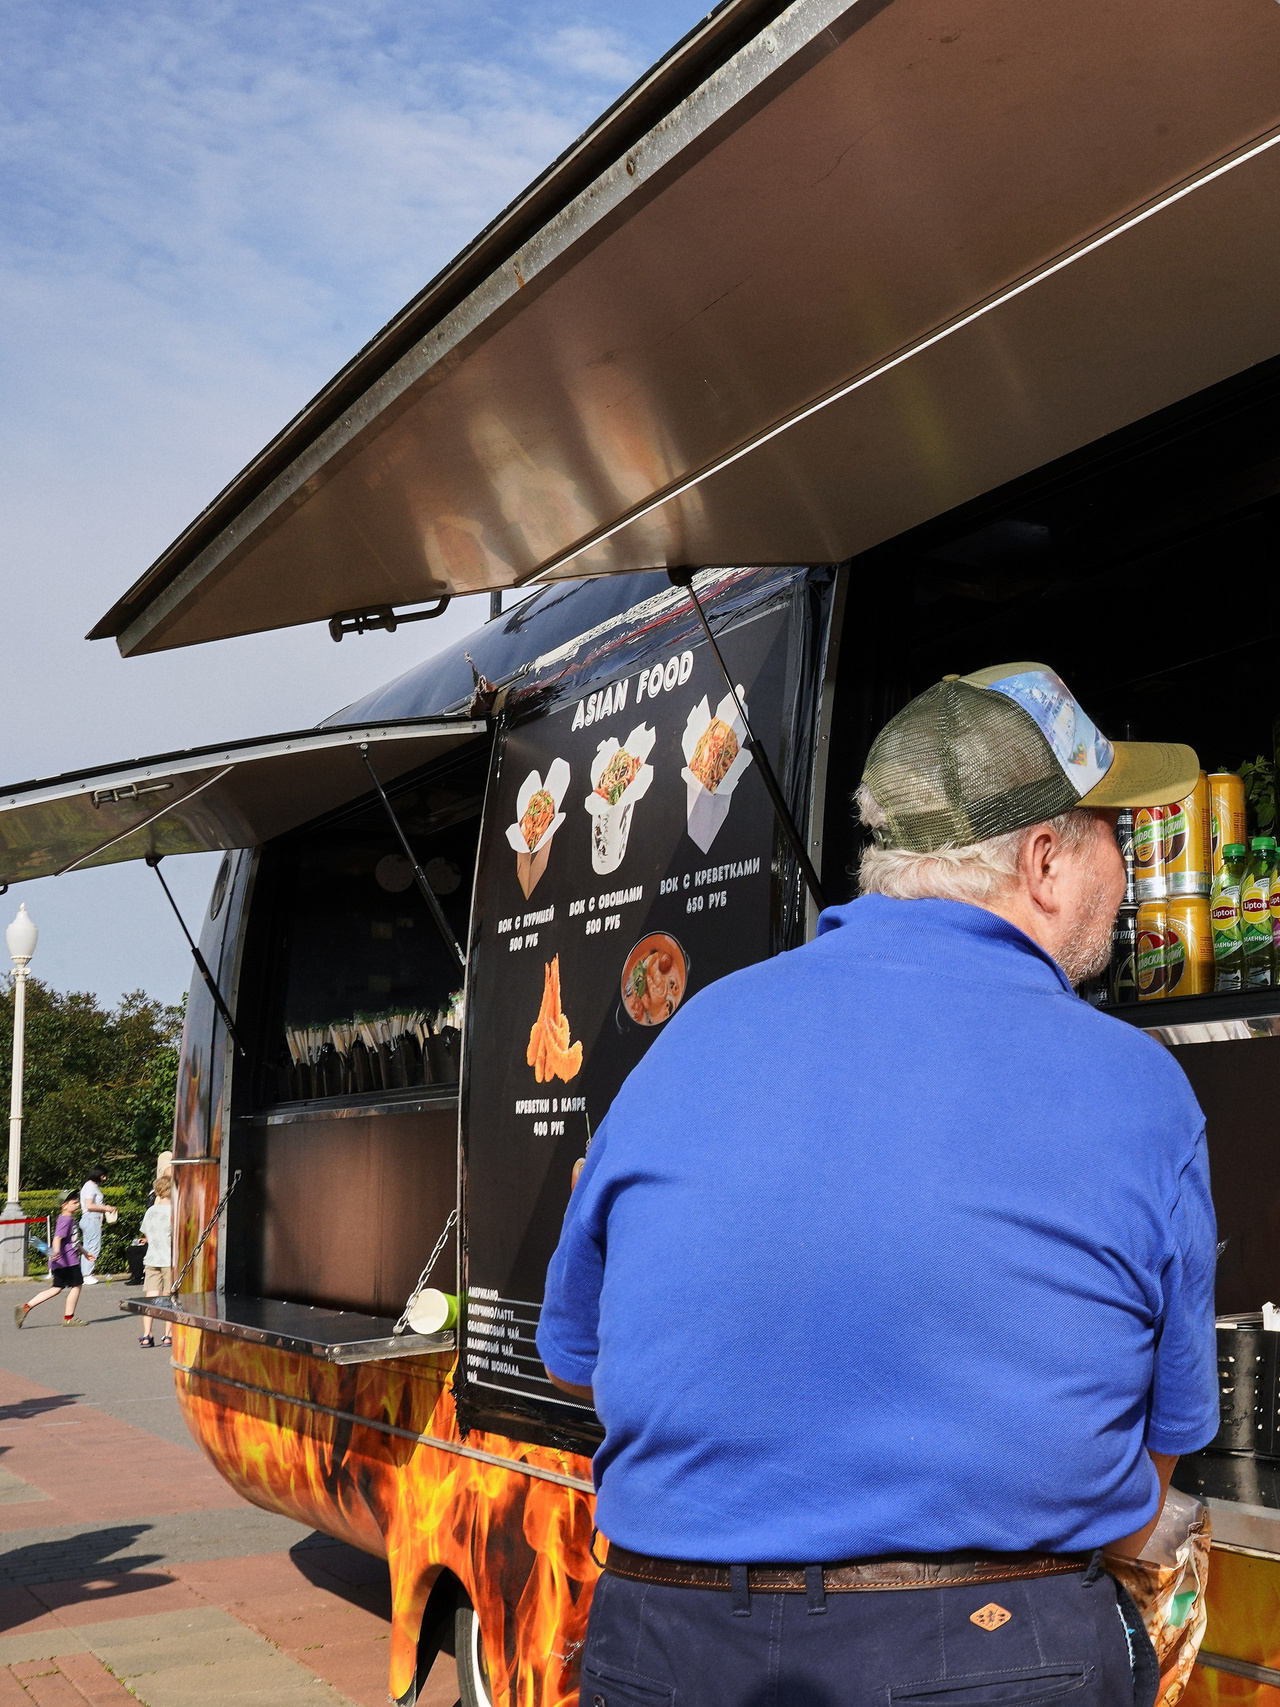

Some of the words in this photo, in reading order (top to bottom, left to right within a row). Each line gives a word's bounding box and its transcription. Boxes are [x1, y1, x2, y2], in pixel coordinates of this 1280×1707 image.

[571, 679, 629, 732] ASIAN
[636, 650, 694, 703] FOOD
[660, 876, 679, 895] ВОК
[683, 873, 691, 889] С
[694, 857, 760, 887] КРЕВЕТКАМИ
[569, 899, 586, 916] ВОК
[588, 896, 596, 912] С
[686, 895, 704, 914] 650
[708, 890, 727, 909] РУБ
[1243, 901, 1267, 910] Lipton
[497, 918, 513, 933] ВОК
[514, 915, 521, 929] С
[522, 904, 555, 928] КУРИЦЕЙ
[1213, 909, 1235, 918] Lipton
[585, 918, 602, 935] 500
[604, 914, 621, 931] РУБ
[525, 933, 539, 948] РУБ
[515, 1099, 550, 1115] КРЕВЕТКИ
[552, 1098, 558, 1113] В
[561, 1096, 586, 1112] КЛЯРЕ
[533, 1121, 548, 1136] 400
[550, 1121, 565, 1136] РУБ
